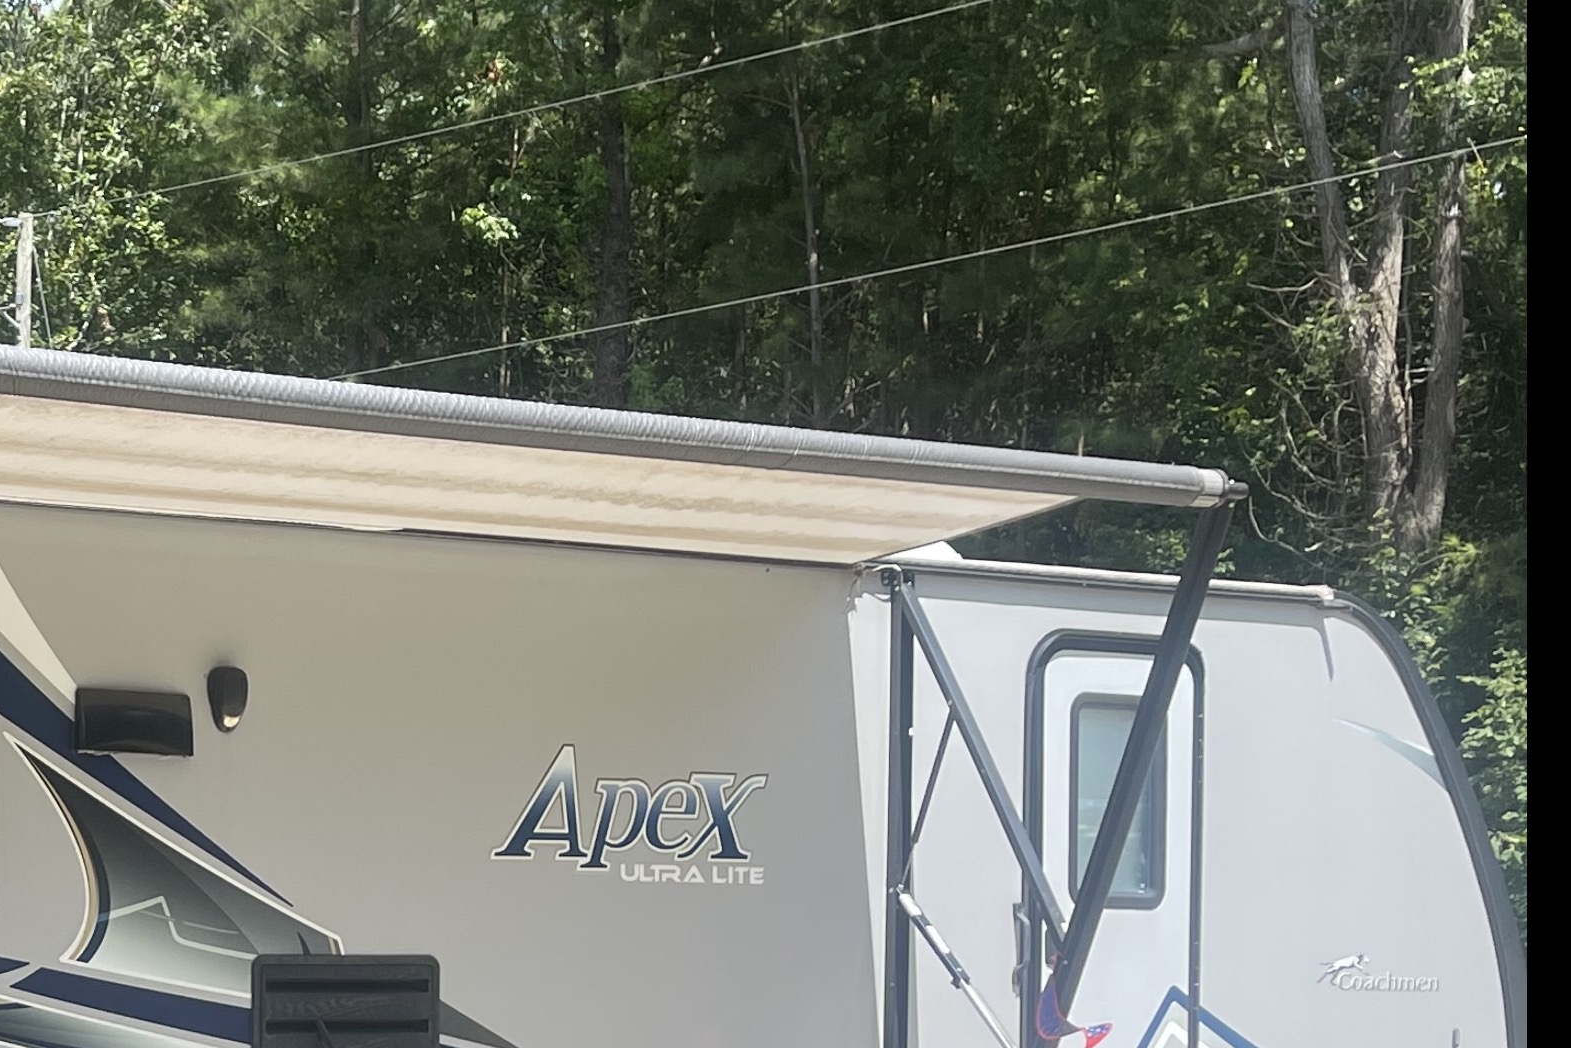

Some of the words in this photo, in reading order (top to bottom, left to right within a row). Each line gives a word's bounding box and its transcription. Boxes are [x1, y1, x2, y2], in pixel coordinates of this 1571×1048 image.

[490, 743, 769, 871] Apex
[619, 863, 706, 884] ULTRA
[711, 865, 765, 885] LITE
[1337, 971, 1440, 992] Coachmen
